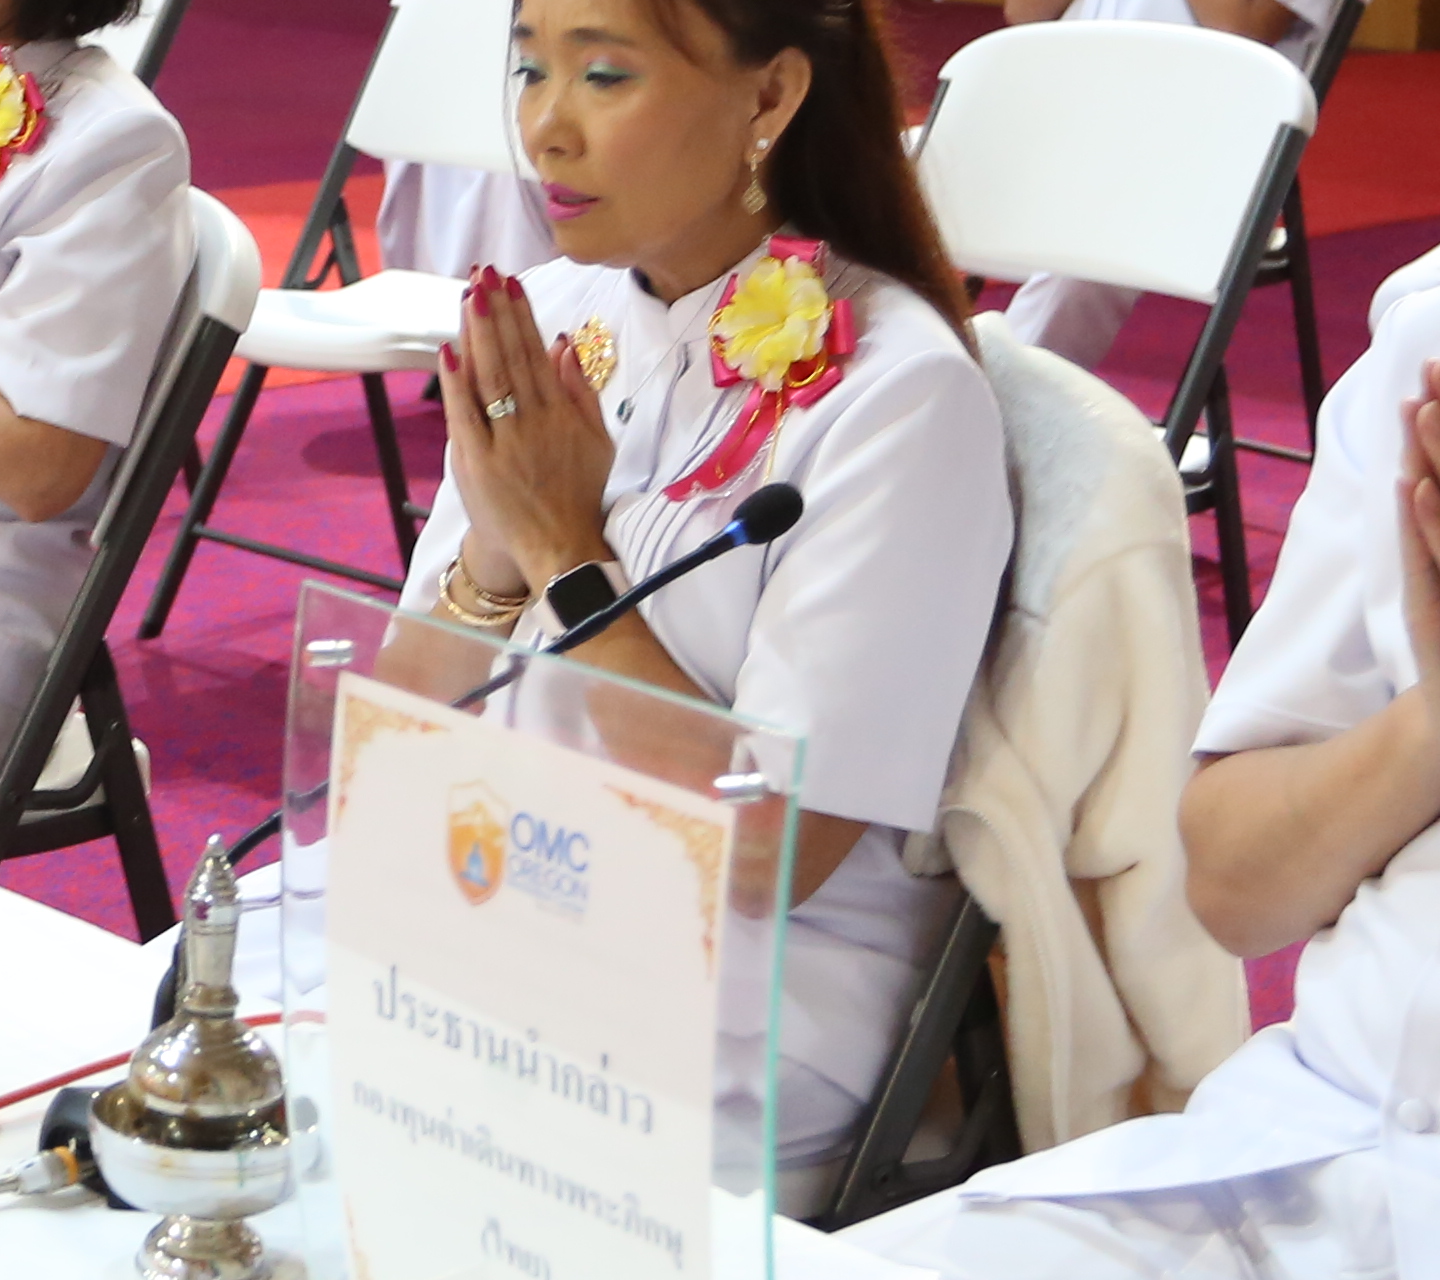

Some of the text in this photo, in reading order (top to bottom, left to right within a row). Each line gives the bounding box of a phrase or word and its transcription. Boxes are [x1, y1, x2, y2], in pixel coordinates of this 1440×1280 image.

[509, 811, 591, 874] OMC
[507, 853, 590, 901] OREGON
[372, 963, 656, 1137] ประธานนำกล่าว
